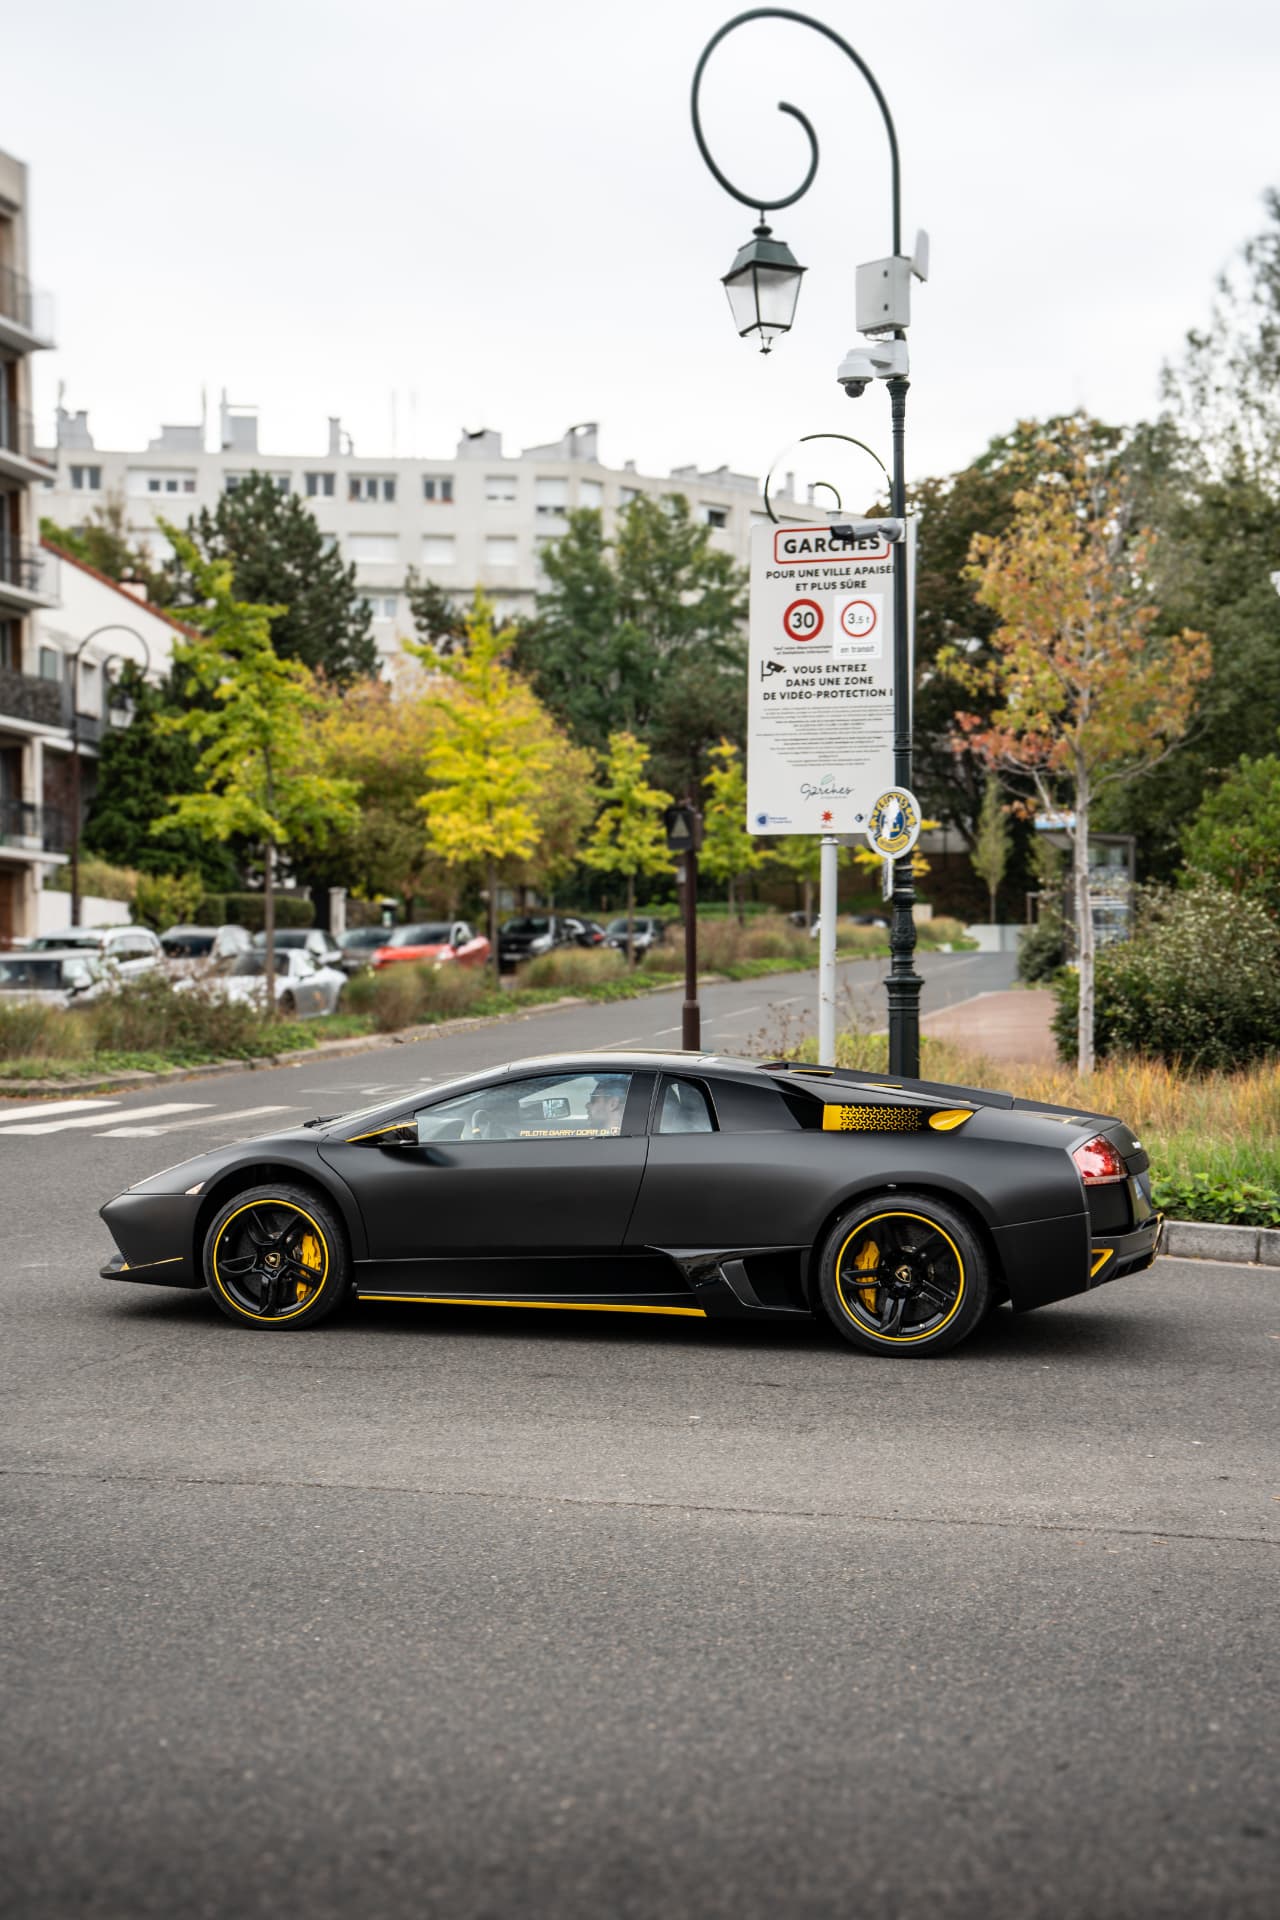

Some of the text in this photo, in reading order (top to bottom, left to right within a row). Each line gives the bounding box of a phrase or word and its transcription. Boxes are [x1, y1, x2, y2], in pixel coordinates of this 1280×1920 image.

[784, 537, 880, 554] GARCHES
[766, 570, 796, 580] POUR
[798, 569, 819, 578] UNE
[822, 567, 851, 577] VILLE
[795, 579, 867, 591] ET PLUS SÛRE
[792, 612, 815, 629] 30
[793, 664, 867, 674] VOUS ENTREZ
[786, 676, 873, 687] DANS UNE ZONE
